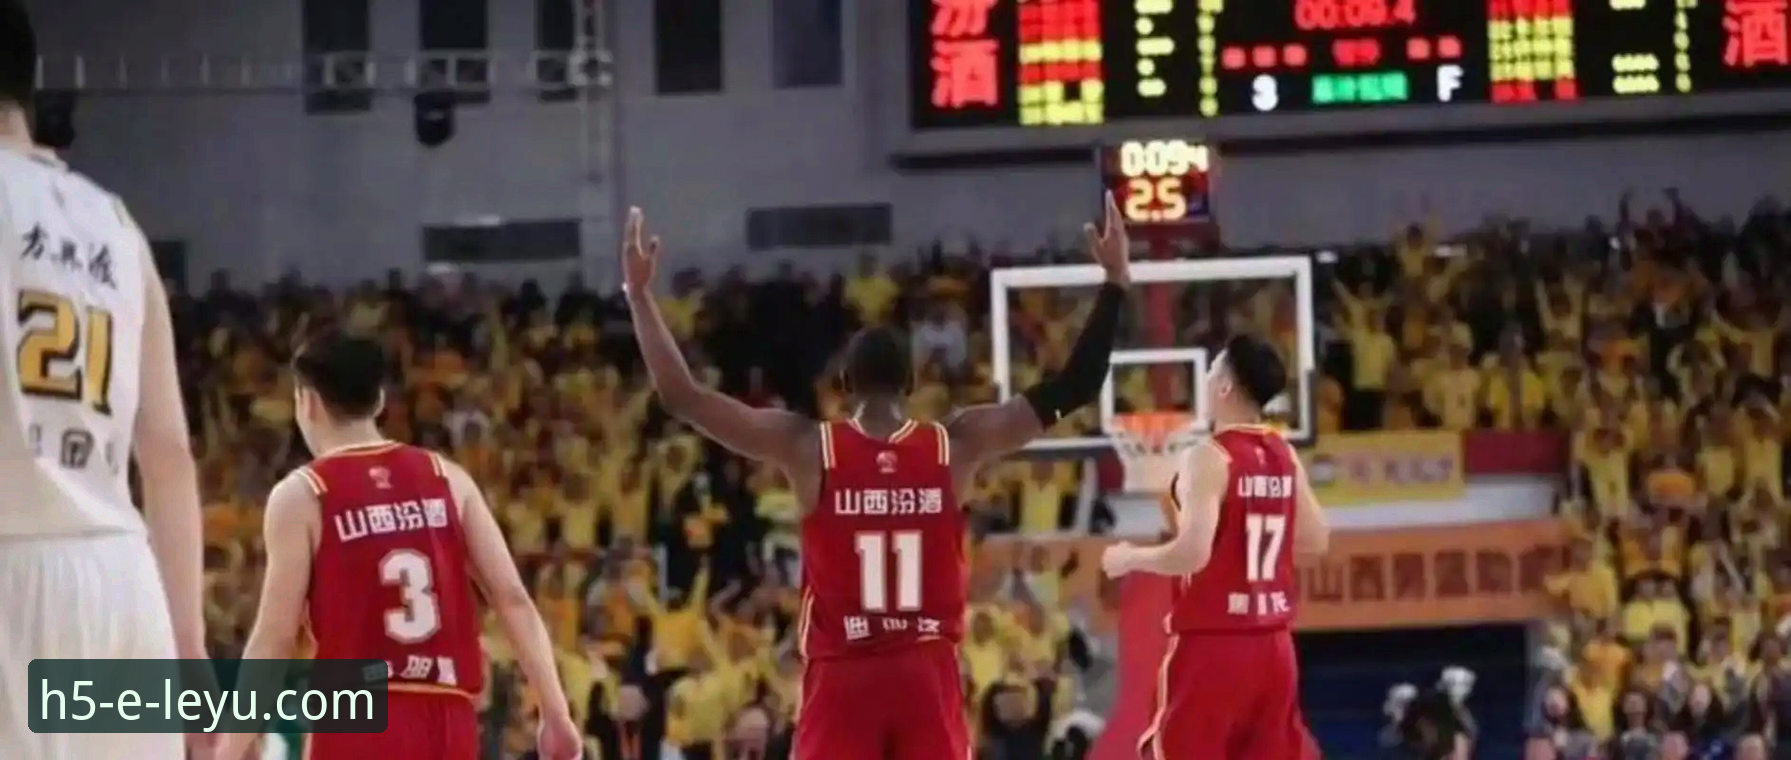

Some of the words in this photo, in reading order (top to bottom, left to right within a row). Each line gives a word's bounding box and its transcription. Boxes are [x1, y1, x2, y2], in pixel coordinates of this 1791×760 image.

[1252, 74, 1279, 111] 3
[1437, 65, 1464, 102] F
[17, 288, 112, 415] 21
[334, 498, 448, 543] 山西汾酒
[835, 488, 943, 515] 山西汾酒
[854, 529, 923, 613] 11
[1246, 512, 1286, 582] 17
[379, 548, 442, 644] 3
